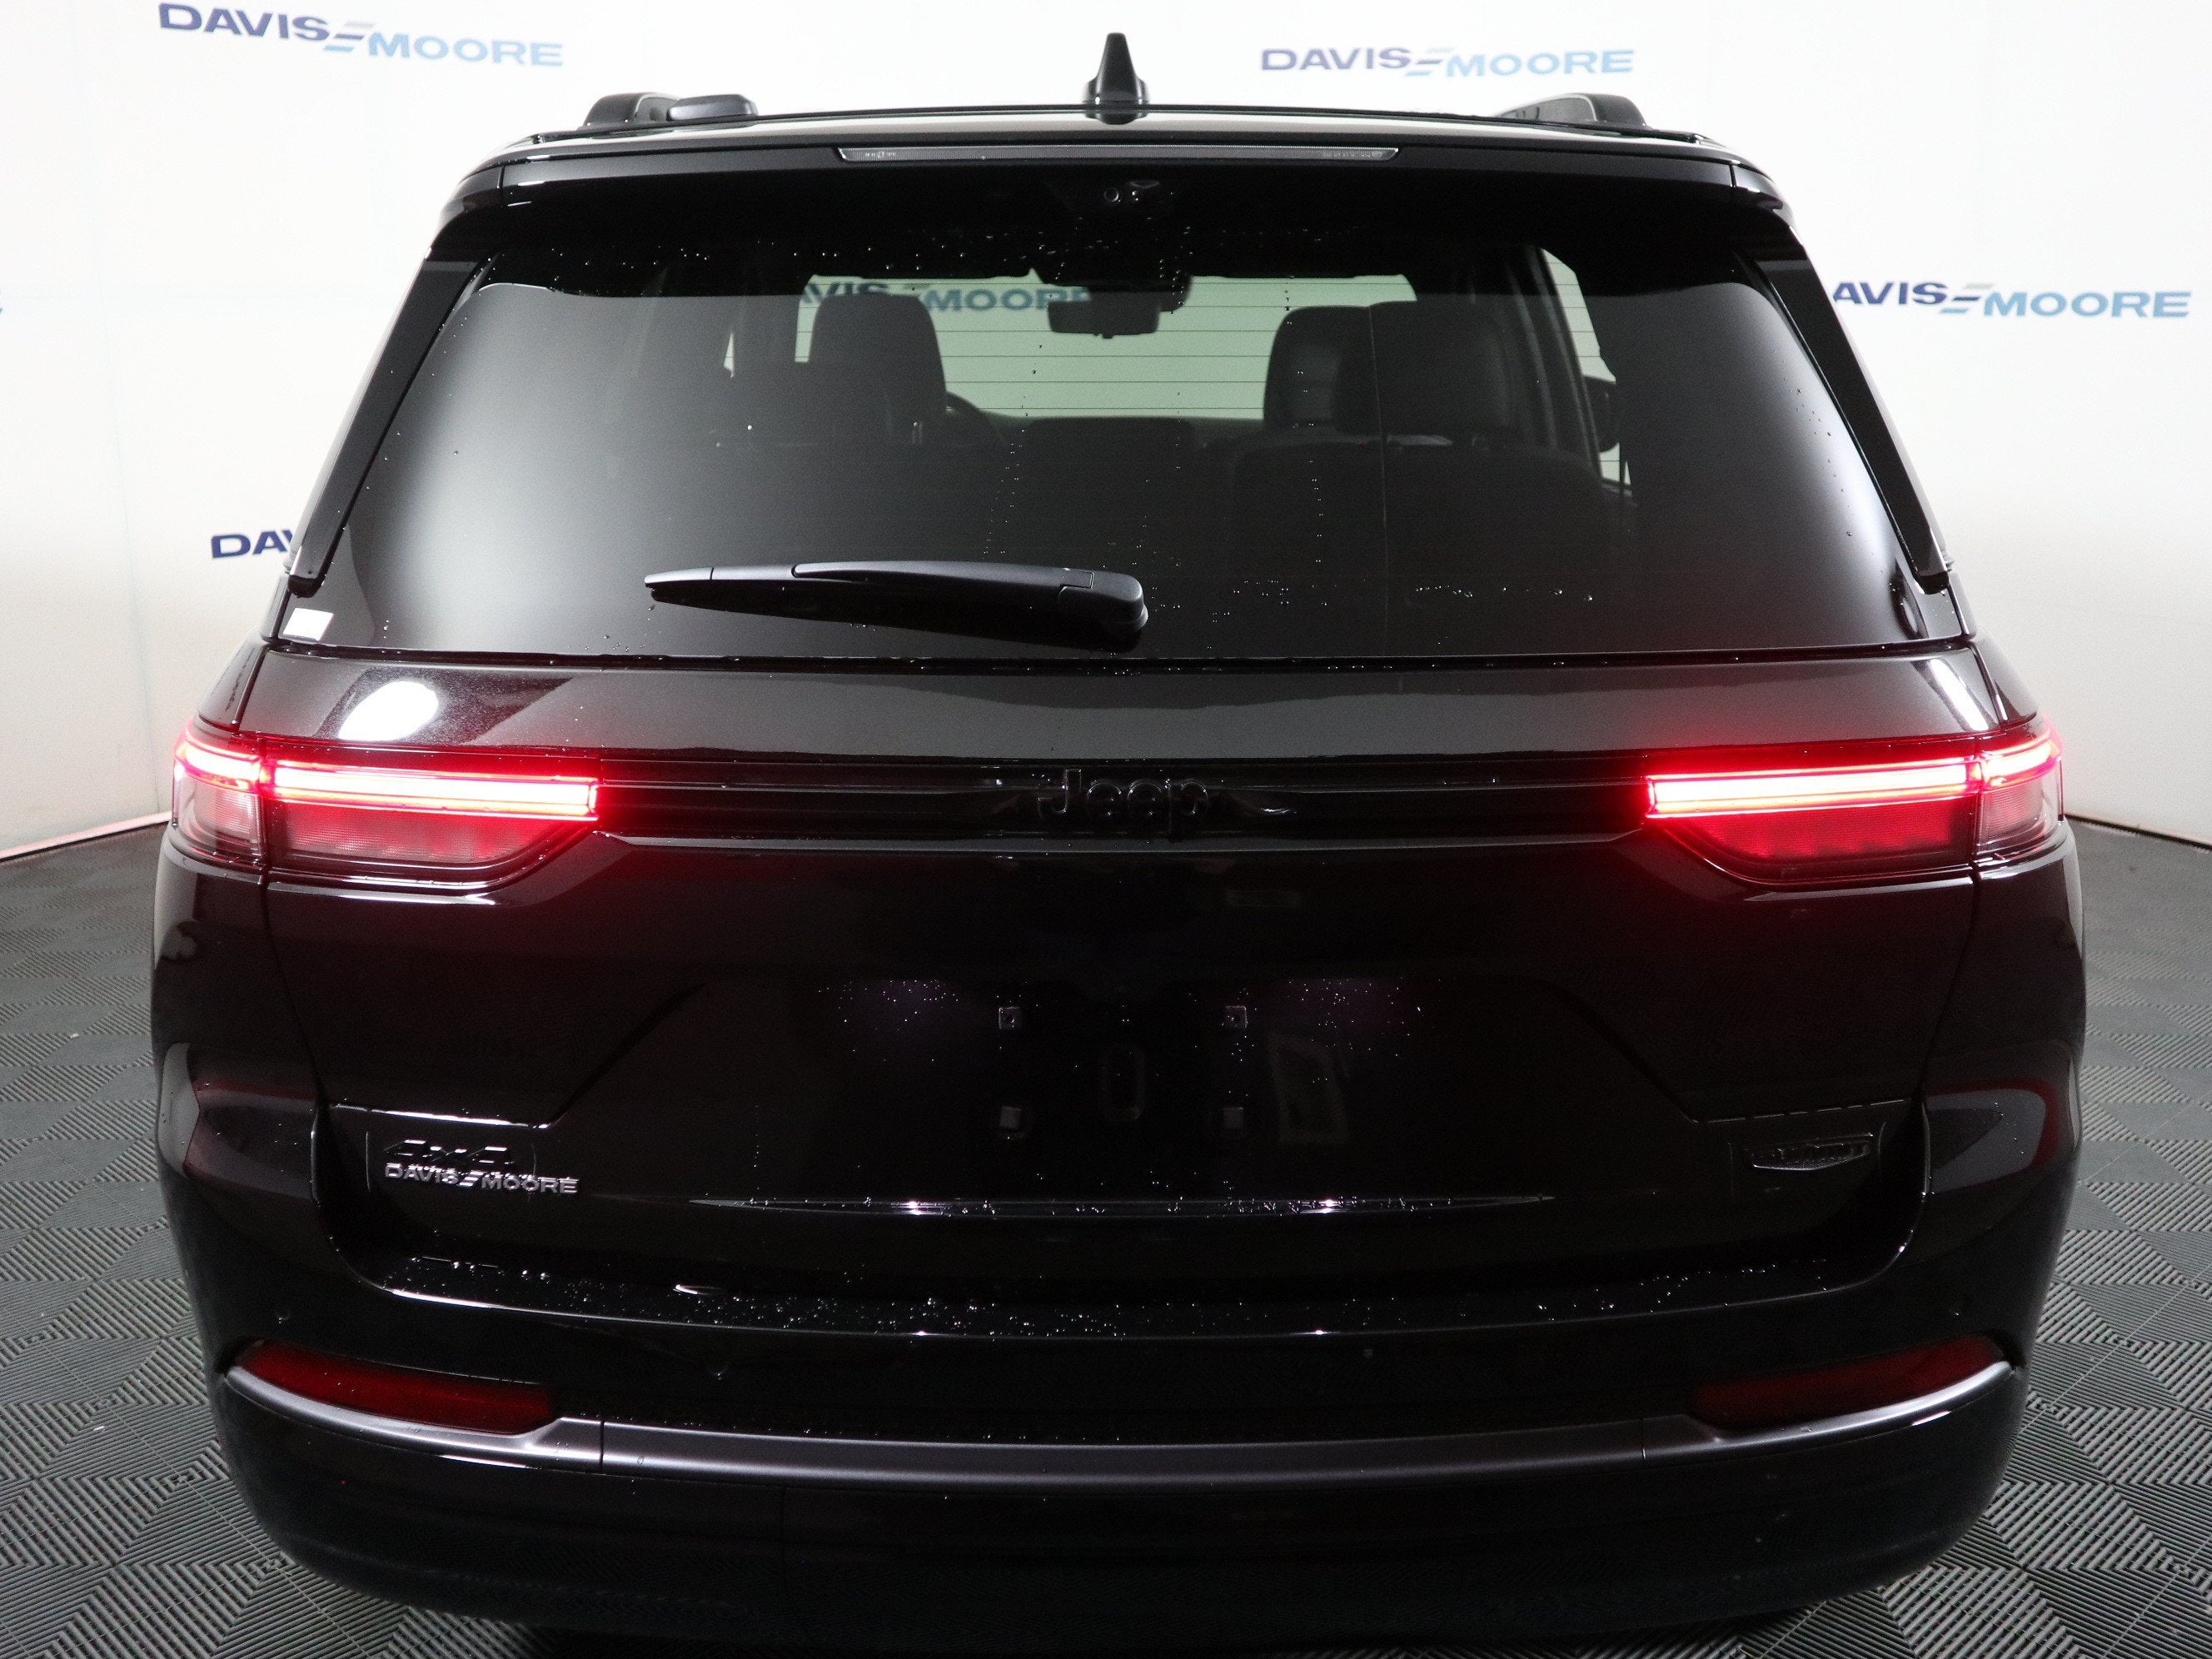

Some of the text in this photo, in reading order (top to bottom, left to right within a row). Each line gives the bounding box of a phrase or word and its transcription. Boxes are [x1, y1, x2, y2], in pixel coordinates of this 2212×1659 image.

[158, 2, 565, 67] DAVIS MOORE
[1260, 47, 1636, 77] DAVIS MOORE
[1983, 291, 2193, 318] MOORE
[1037, 767, 1208, 841] Jeep
[384, 1163, 580, 1194] DAVIS MOORE
